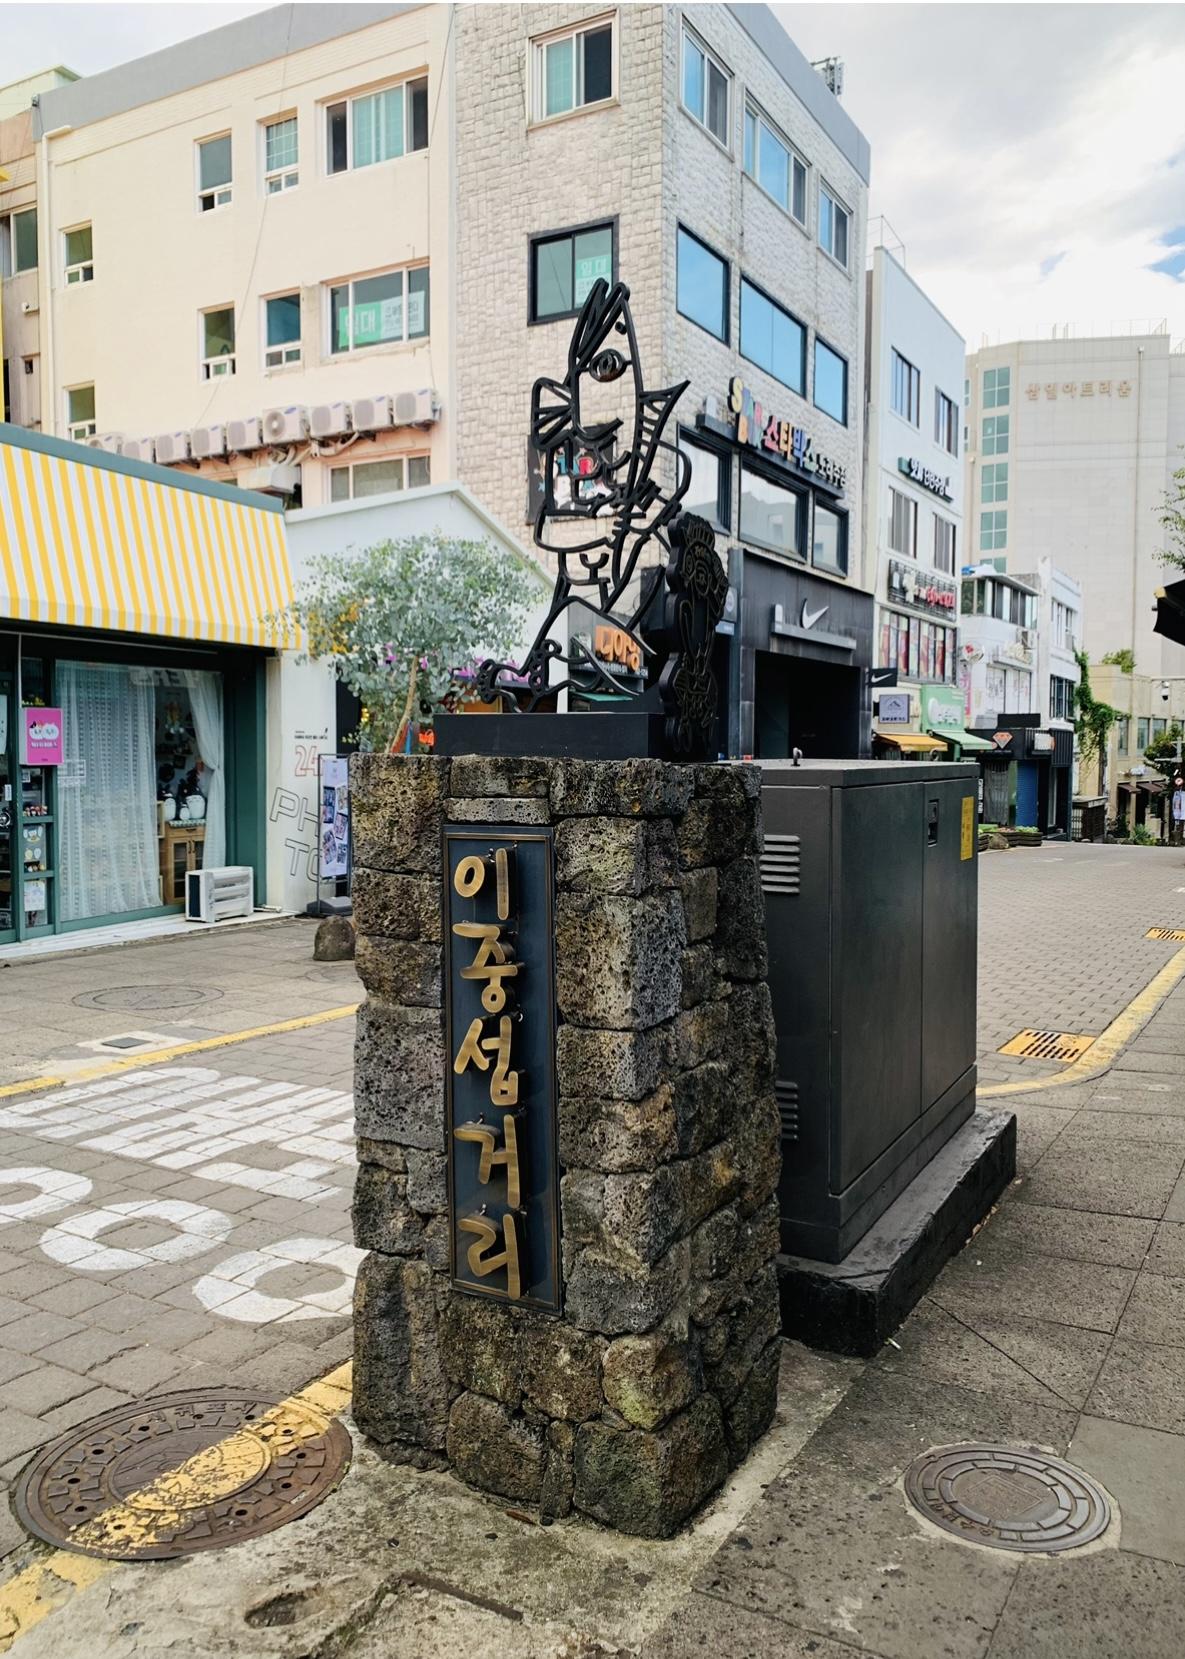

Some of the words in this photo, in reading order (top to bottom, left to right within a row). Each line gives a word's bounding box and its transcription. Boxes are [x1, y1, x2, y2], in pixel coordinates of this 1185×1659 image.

[1025, 381, 1132, 401] 삼일아트리움
[453, 846, 521, 1300] 이중섭거리
[148, 1401, 257, 1422] 서귀포시
